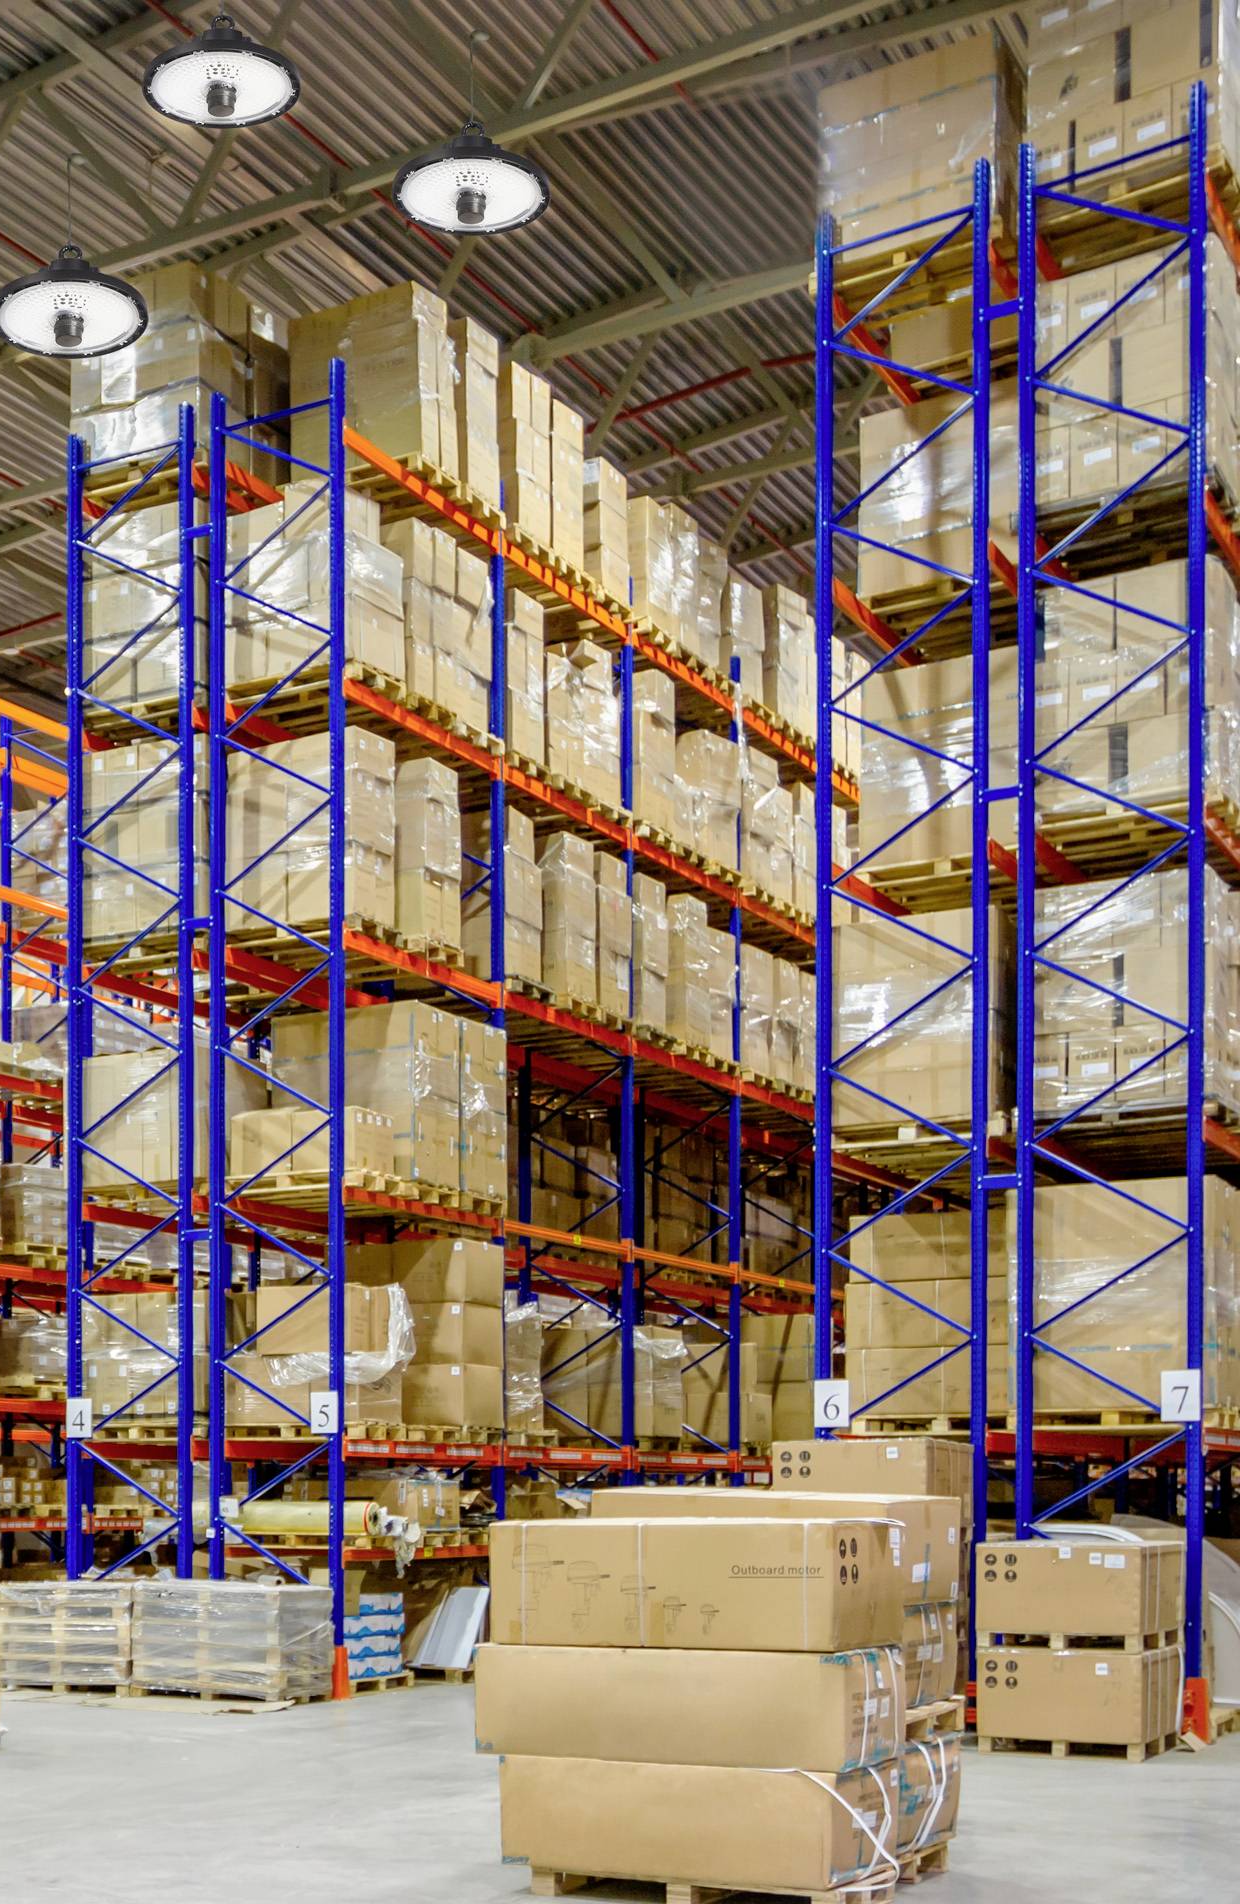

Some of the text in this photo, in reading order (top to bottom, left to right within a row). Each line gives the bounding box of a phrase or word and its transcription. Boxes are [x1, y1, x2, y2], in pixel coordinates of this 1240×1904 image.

[823, 1394, 840, 1420] 6
[1171, 1385, 1190, 1414] 7
[71, 1410, 85, 1431] 4
[317, 1404, 330, 1428] 5
[731, 1564, 821, 1576] Outboard motor
